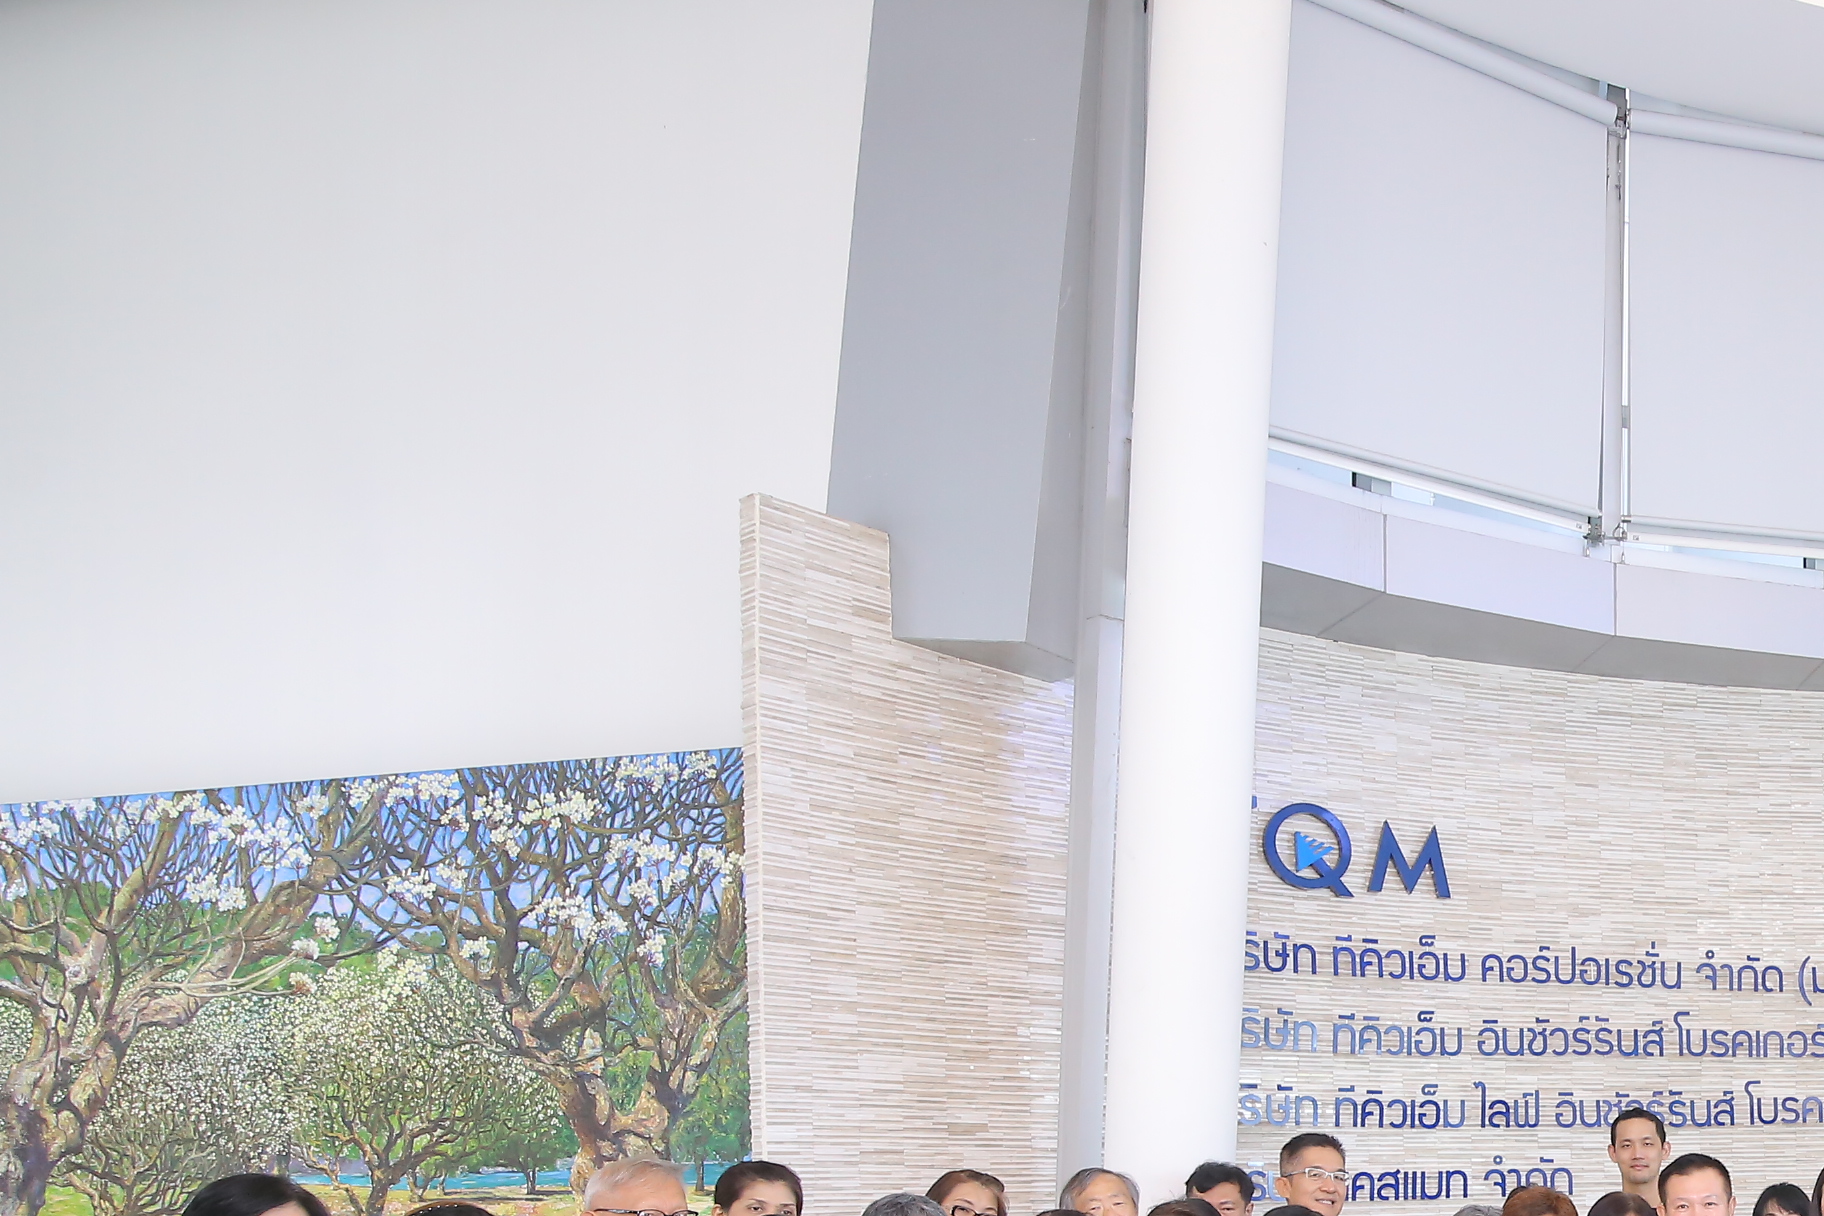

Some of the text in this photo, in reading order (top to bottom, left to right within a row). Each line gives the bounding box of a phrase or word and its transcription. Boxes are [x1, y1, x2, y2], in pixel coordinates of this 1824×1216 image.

[1252, 795, 1451, 898] QM
[1244, 931, 1317, 975] ริษัท
[1332, 934, 1467, 982] ทีคิวเอ็ม
[1481, 941, 1682, 989] คอร์ปอเรชั่น
[1696, 950, 1784, 993] จำกัด
[1241, 1008, 1318, 1052] ริษัท
[1332, 1010, 1463, 1056] ทีคิวเอ็ม
[1477, 1015, 1665, 1057] อินชัวร์รันส์
[1238, 1083, 1318, 1126] ริษัท
[1334, 1084, 1466, 1128] ทีคิวเอ็ม
[1473, 1081, 1541, 1128] ไลฟ์
[1483, 1154, 1574, 1199] จำกัด
